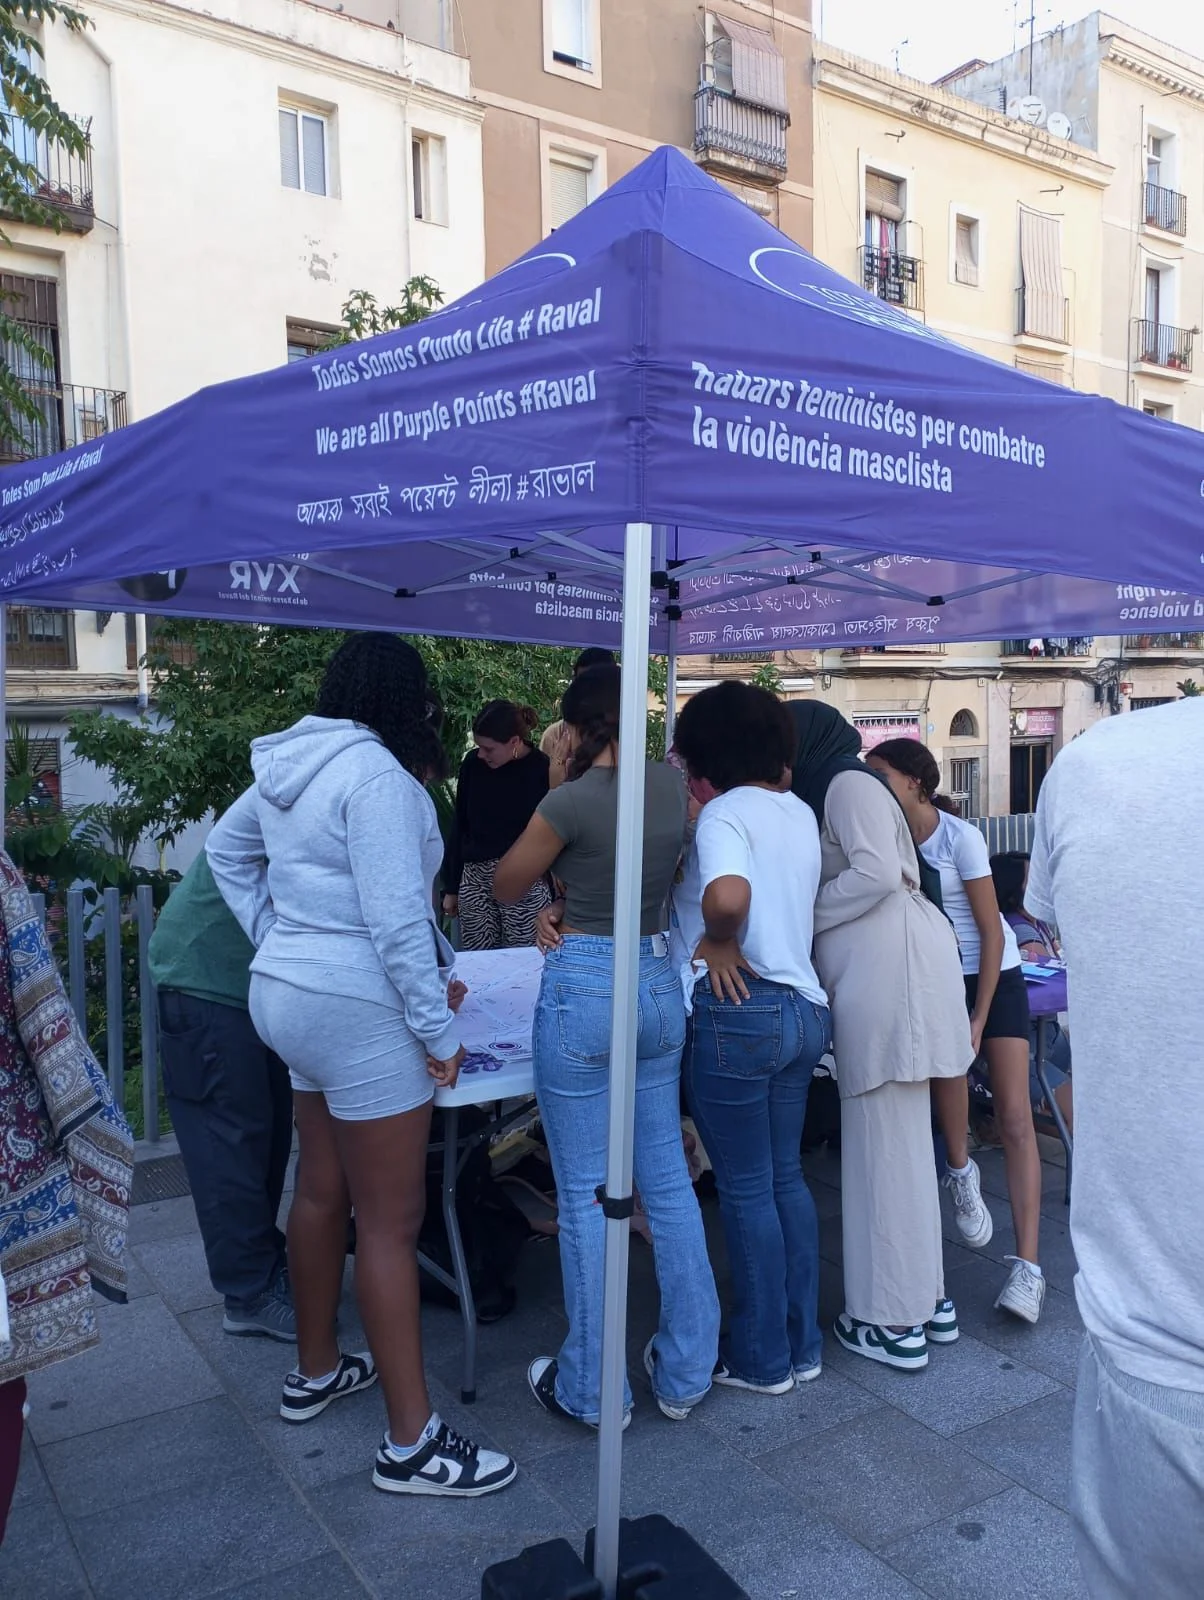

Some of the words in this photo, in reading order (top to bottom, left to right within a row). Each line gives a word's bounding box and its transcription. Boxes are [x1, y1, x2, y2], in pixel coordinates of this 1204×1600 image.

[312, 360, 359, 392] Todas
[358, 344, 416, 381] Somos
[418, 328, 472, 366] Punto
[477, 316, 513, 351] Lila
[518, 309, 534, 341] #
[537, 287, 602, 336] Raval
[316, 427, 337, 455] We
[341, 424, 366, 450] are
[370, 411, 390, 445] all
[394, 401, 450, 441] Purple
[453, 388, 516, 425] Points
[519, 370, 596, 415] #Raval
[692, 406, 718, 450] la
[726, 416, 842, 474] violència
[849, 446, 953, 494] masclista
[796, 379, 917, 438] feministes
[921, 413, 956, 449] per
[959, 423, 1046, 468] combatre
[2, 487, 22, 507] Totes
[23, 479, 40, 498] Som
[297, 497, 343, 525] আমরা
[350, 483, 392, 519] সবাই
[469, 465, 512, 505] লীলা
